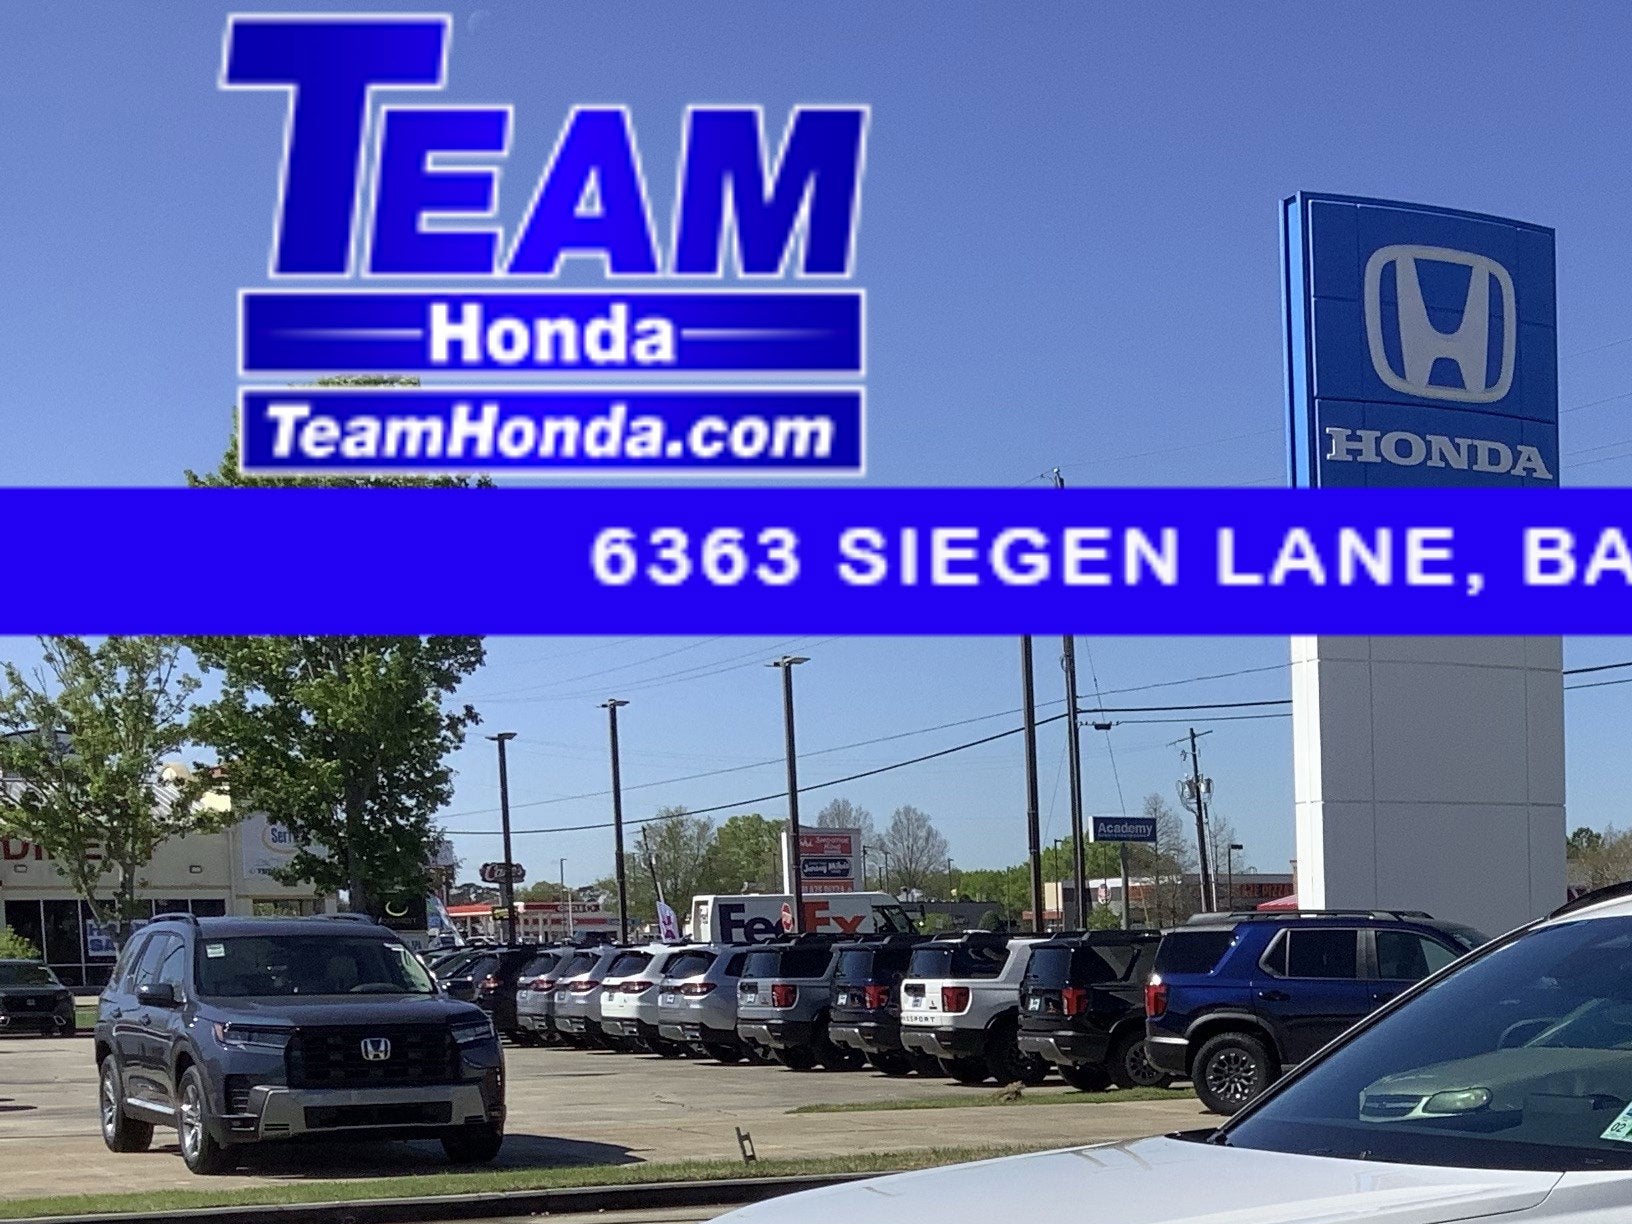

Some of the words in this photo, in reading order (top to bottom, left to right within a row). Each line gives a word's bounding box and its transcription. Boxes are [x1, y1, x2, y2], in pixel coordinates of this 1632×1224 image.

[1326, 427, 1553, 480] HONDA
[1098, 822, 1153, 835] Academy
[1610, 1122, 1626, 1133] 02
